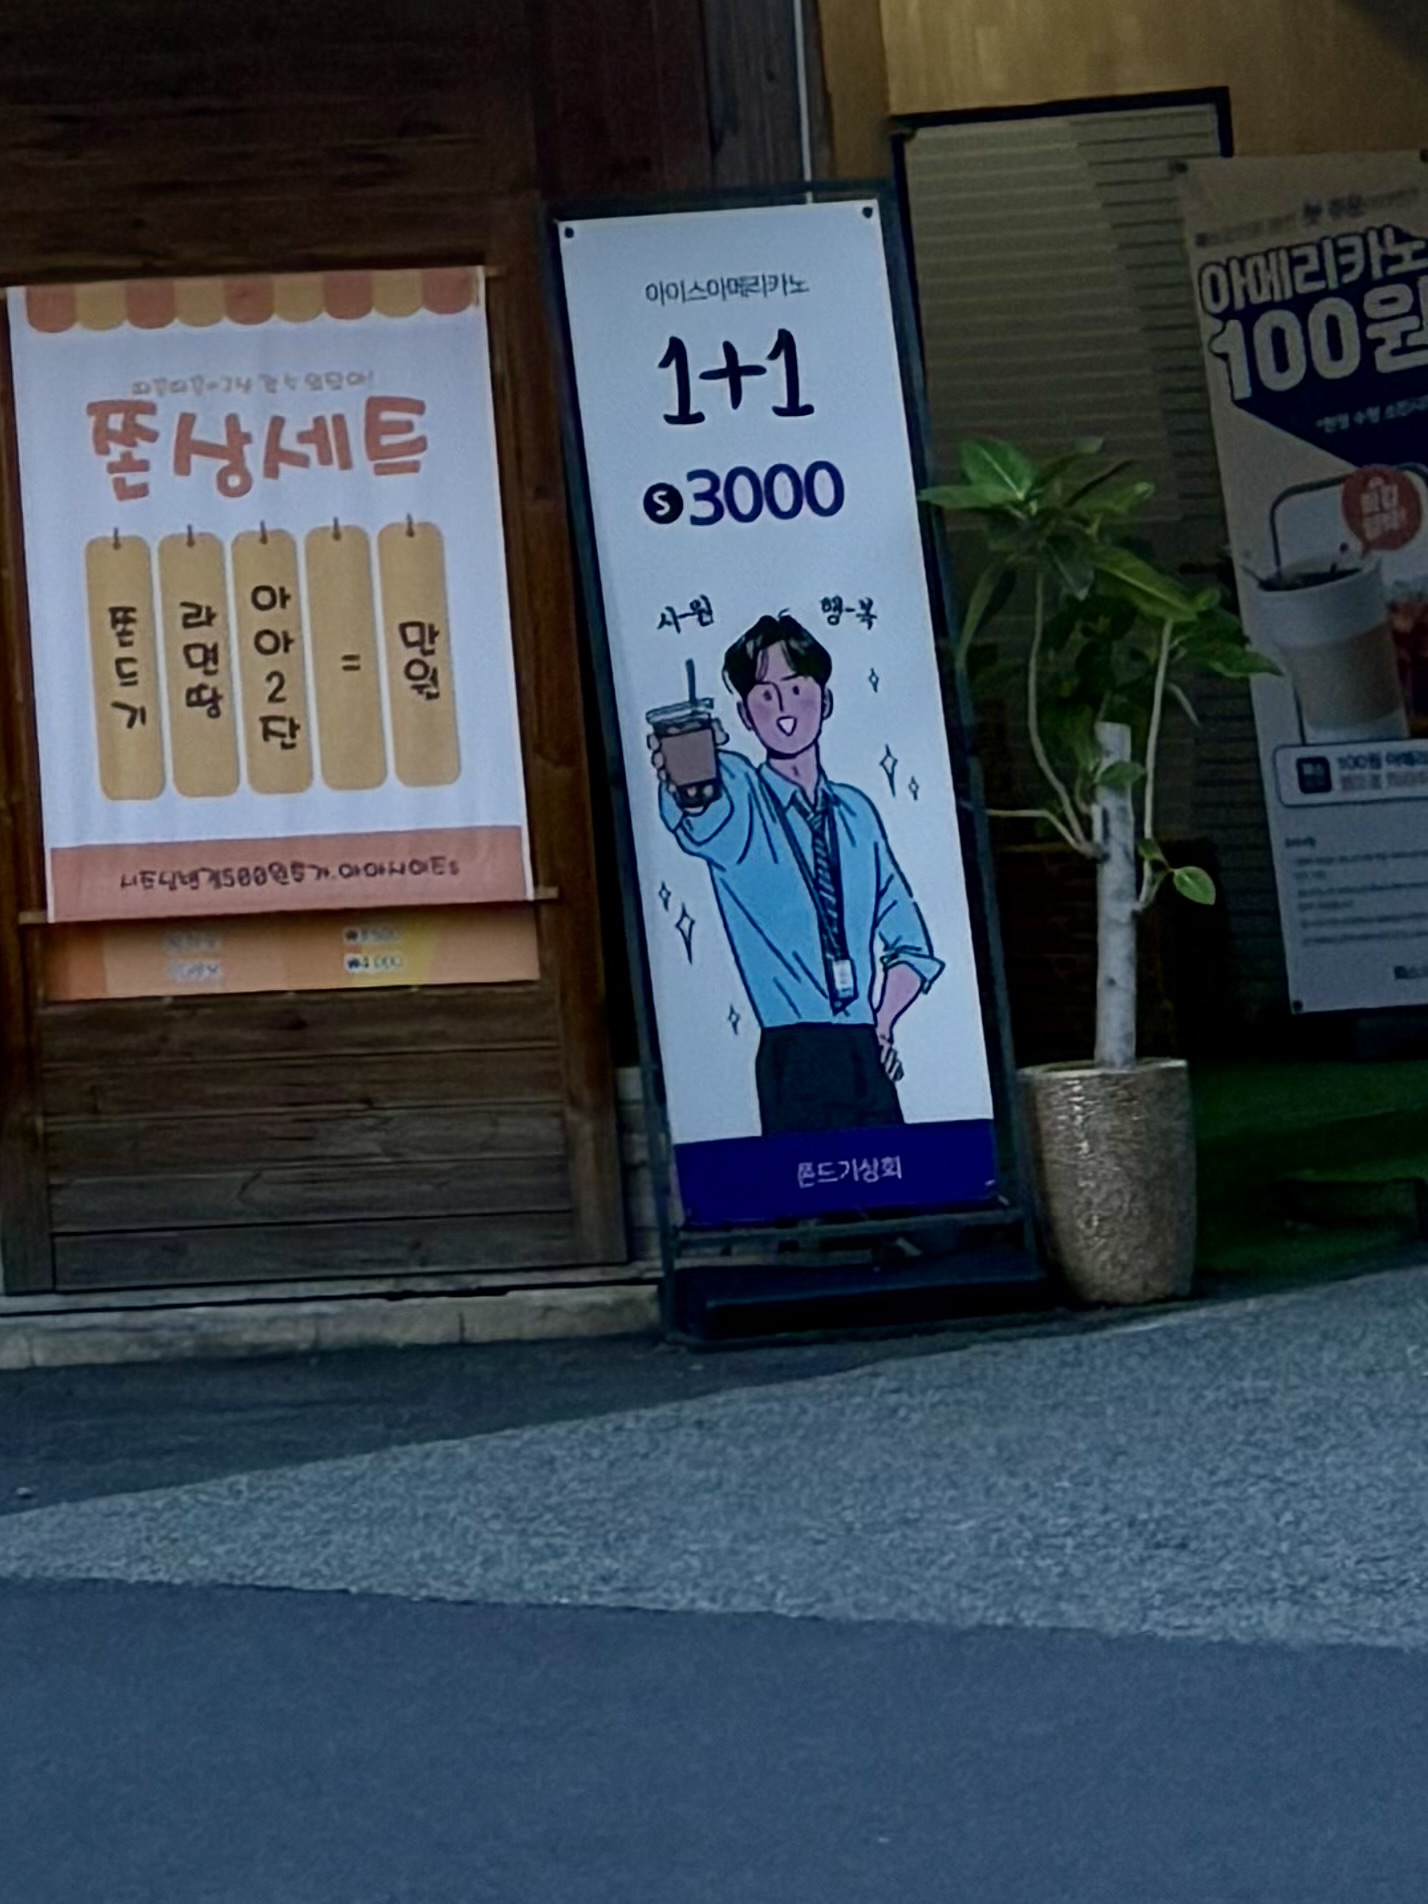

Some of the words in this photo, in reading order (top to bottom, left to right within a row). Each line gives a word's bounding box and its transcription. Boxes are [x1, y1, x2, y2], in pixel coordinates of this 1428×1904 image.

[645, 272, 812, 307] 아이스아메리카노
[1199, 224, 1428, 315] 아메리카노
[657, 328, 815, 425] 1+1
[1210, 275, 1428, 401] 100원
[85, 395, 428, 502] 쫀상세트
[686, 460, 846, 527] 3000
[108, 605, 147, 730] 쫀드기
[179, 601, 222, 719] 라면땅
[398, 620, 440, 700] 만원
